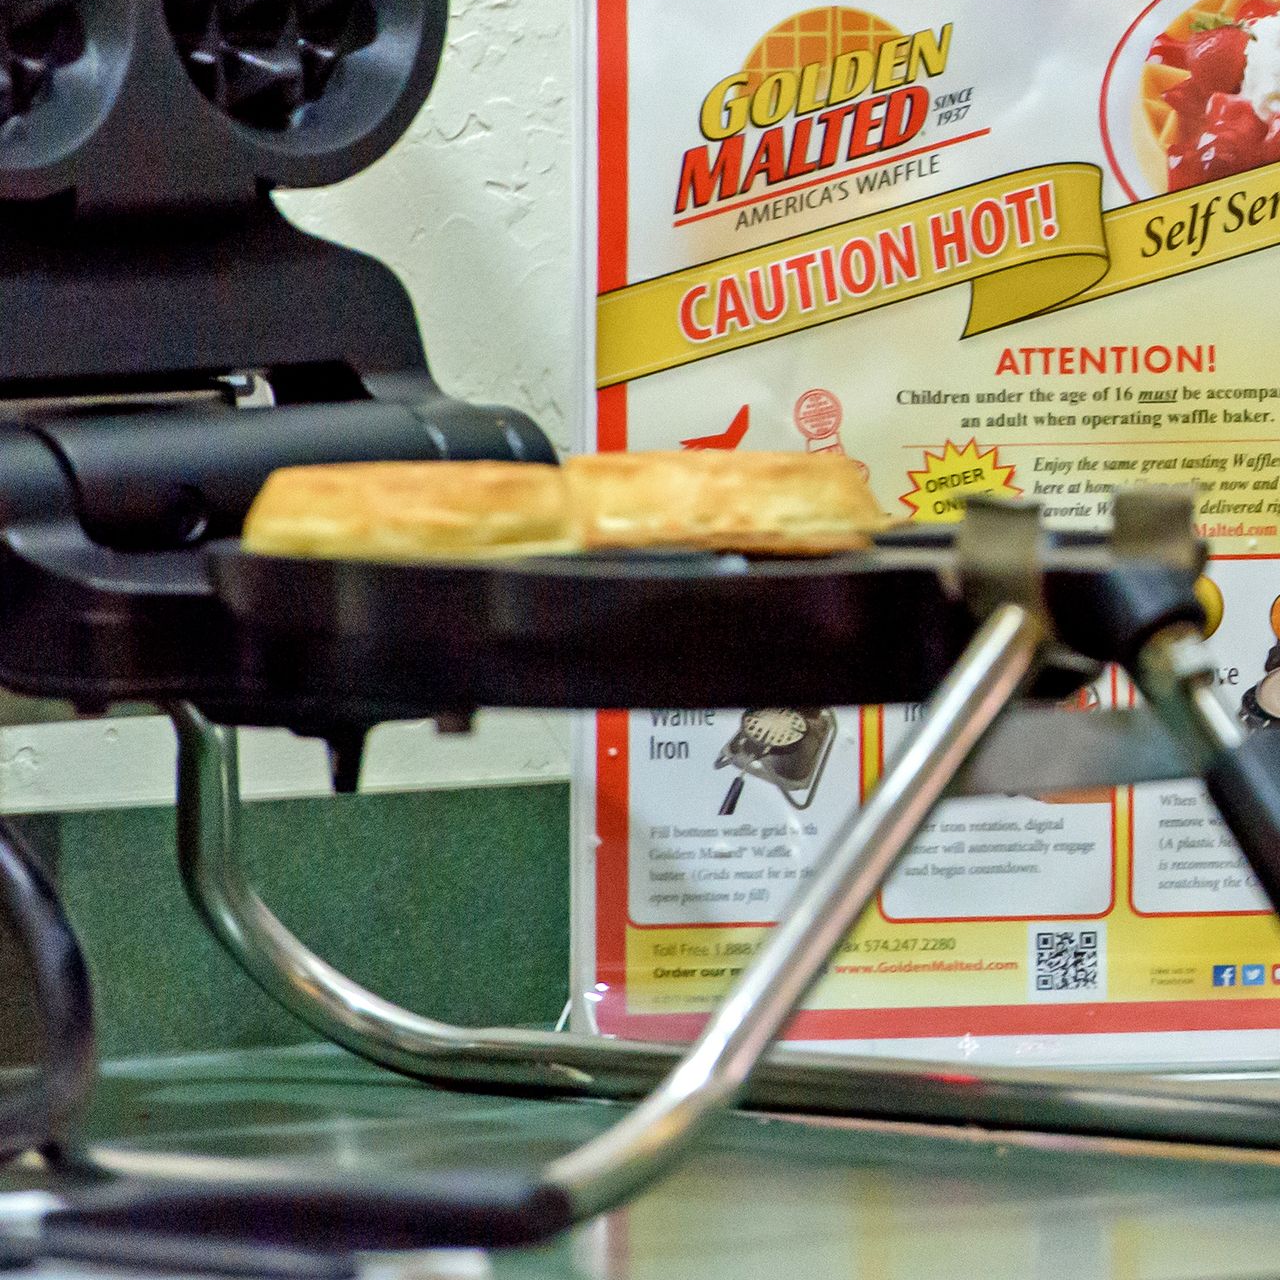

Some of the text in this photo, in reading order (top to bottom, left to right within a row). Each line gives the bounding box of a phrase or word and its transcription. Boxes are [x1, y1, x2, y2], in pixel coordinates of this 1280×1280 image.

[700, 22, 954, 142] GOLDEN
[933, 87, 975, 112] SINCE
[937, 104, 972, 127] 1937
[674, 85, 930, 215] MALTED
[734, 153, 942, 232] AMERICA'S WAFFLE
[1141, 195, 1218, 258] Self
[678, 181, 1058, 344] CAUTION HOT!
[994, 344, 1217, 377] ATTENTION!
[896, 389, 970, 405] Children
[976, 388, 1024, 404] under
[1029, 387, 1057, 402] the
[1059, 391, 1087, 406] age
[1092, 387, 1110, 402] of
[1115, 386, 1133, 401] 16
[1138, 387, 1178, 403] must
[1182, 386, 1201, 400] be
[961, 409, 1275, 429] an adult when operating waffle baker.
[1033, 457, 1073, 475] Enjoy
[1077, 456, 1099, 471] the
[1103, 459, 1138, 471] same
[1141, 456, 1177, 473] great
[1181, 454, 1228, 471] tasting
[925, 468, 985, 493] ORDER
[1033, 481, 1063, 495] here
[1067, 481, 1080, 494] at
[1220, 479, 1248, 491] now
[1252, 476, 1280, 490] and
[1040, 501, 1092, 517] avorite
[1200, 499, 1262, 515] delivered
[649, 736, 690, 760] Iron
[680, 942, 709, 956] Free
[863, 937, 956, 953] 574.247.2280
[653, 967, 696, 979] Order
[701, 968, 726, 977] our
[834, 958, 1019, 975] www.GoldenMalted.com
